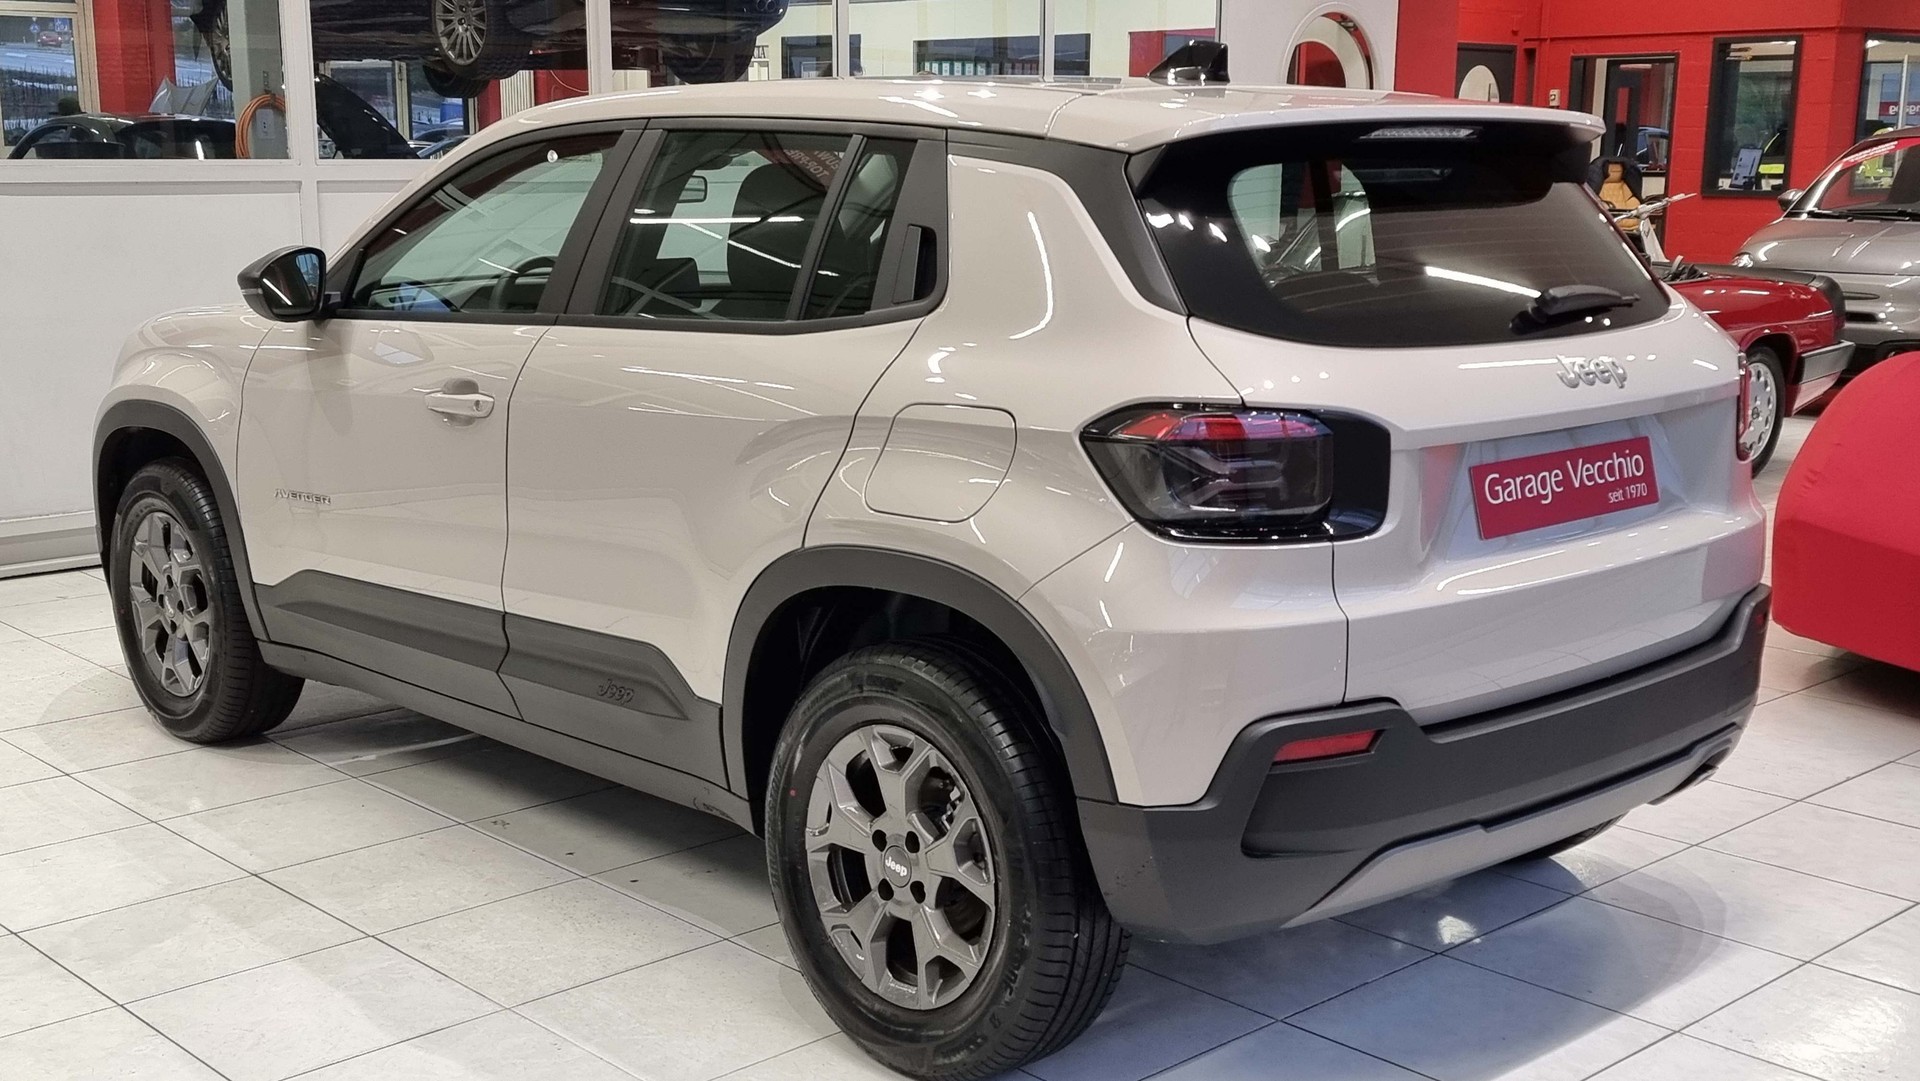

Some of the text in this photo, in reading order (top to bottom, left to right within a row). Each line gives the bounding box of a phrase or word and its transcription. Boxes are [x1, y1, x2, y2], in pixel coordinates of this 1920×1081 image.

[1556, 354, 1628, 389] Jeep
[1484, 450, 1645, 504] Garage Vecchio
[273, 488, 332, 505] AVENGER
[1607, 483, 1648, 504] seit 1970
[596, 678, 635, 706] Jeep
[885, 855, 908, 877] Jeep
